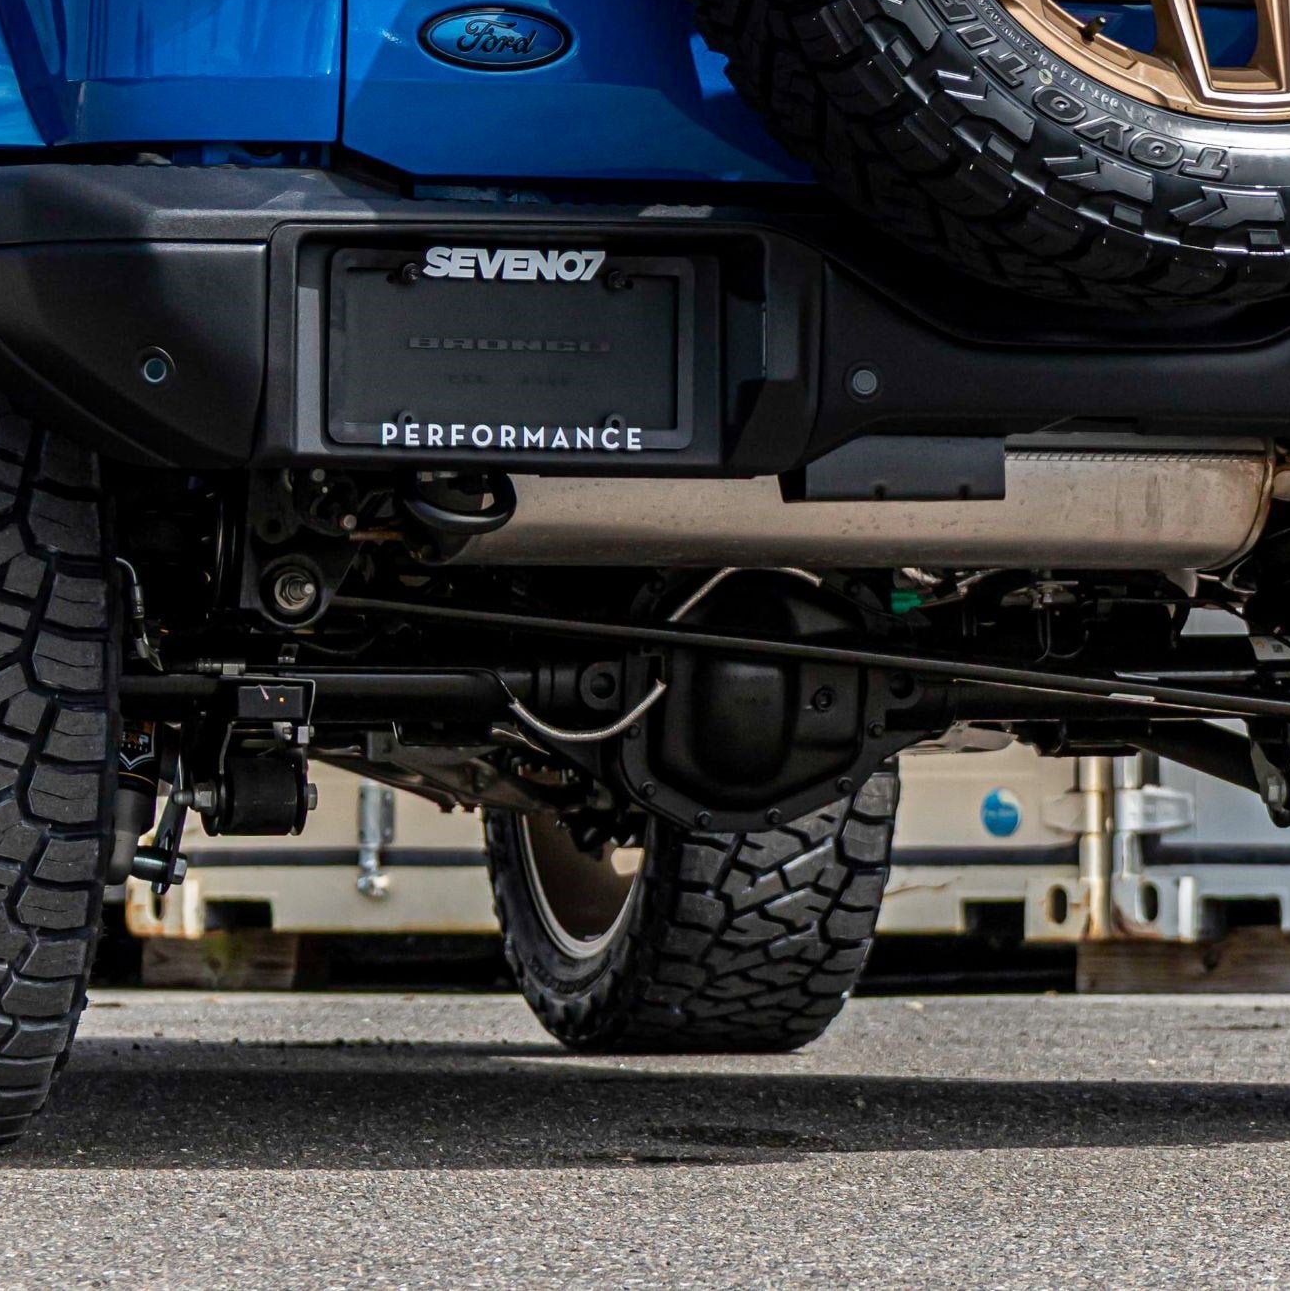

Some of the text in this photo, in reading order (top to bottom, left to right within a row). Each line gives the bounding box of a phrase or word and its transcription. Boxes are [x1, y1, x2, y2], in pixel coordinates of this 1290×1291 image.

[455, 18, 539, 56] Ford
[1032, 83, 1228, 179] TOYO
[408, 337, 612, 353] BRONCO
[381, 422, 643, 451] PERFORMANCE
